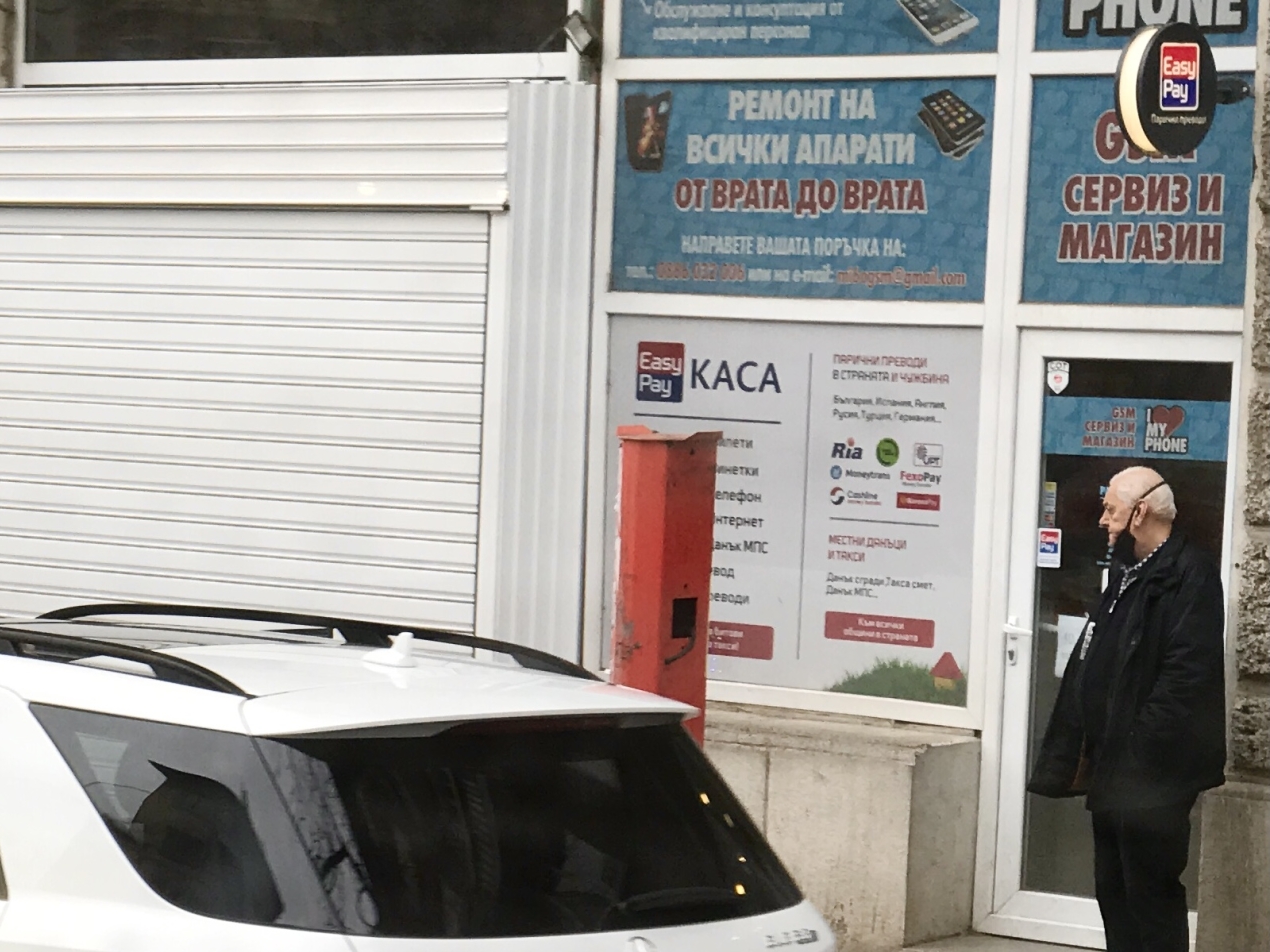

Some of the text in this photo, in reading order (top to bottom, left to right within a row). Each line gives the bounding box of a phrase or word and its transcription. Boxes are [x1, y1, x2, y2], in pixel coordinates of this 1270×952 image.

[1067, 0, 1244, 31] PHONE
[1163, 56, 1196, 80] Easy
[1163, 80, 1188, 104] Pay
[729, 88, 877, 120] РЕМОНТ НА
[686, 133, 916, 164] ВСИЧКИ АПАРАТИ
[675, 178, 927, 217] ОТ ВРАТА ДО ВРАТА
[1063, 174, 1224, 214] СЕРВИЗ И
[681, 235, 907, 257] НАПРАВЕТЕ ВАШАТА ПОРЪЧКА НА:
[1057, 222, 1224, 263] МАГАЗИН
[639, 352, 682, 376] Easy
[833, 354, 927, 368] ПАРИЧНИ ПРЕВОДИ
[691, 359, 781, 393] КАСА
[833, 370, 949, 384] В СТРАНАТА И ЧУЖБИНА
[639, 374, 672, 398] Pay
[1112, 407, 1135, 420] GSM
[1085, 421, 1135, 434] СЕРВИЗ И
[1146, 423, 1167, 437] MY
[717, 438, 754, 449] илети
[831, 437, 863, 459] Ria
[1082, 435, 1135, 449] МАГАЗИН
[1145, 438, 1187, 452] PHONE
[716, 465, 759, 476] инетки
[715, 489, 761, 505] елефон
[714, 515, 764, 529] нтернет
[743, 540, 768, 554] МПС
[828, 535, 907, 550] МЕСТНИ ДАНЪЦИ
[828, 550, 865, 562] И ТАКСИ
[711, 567, 735, 579] вод
[826, 572, 853, 583] Данък
[826, 585, 853, 596] Данък
